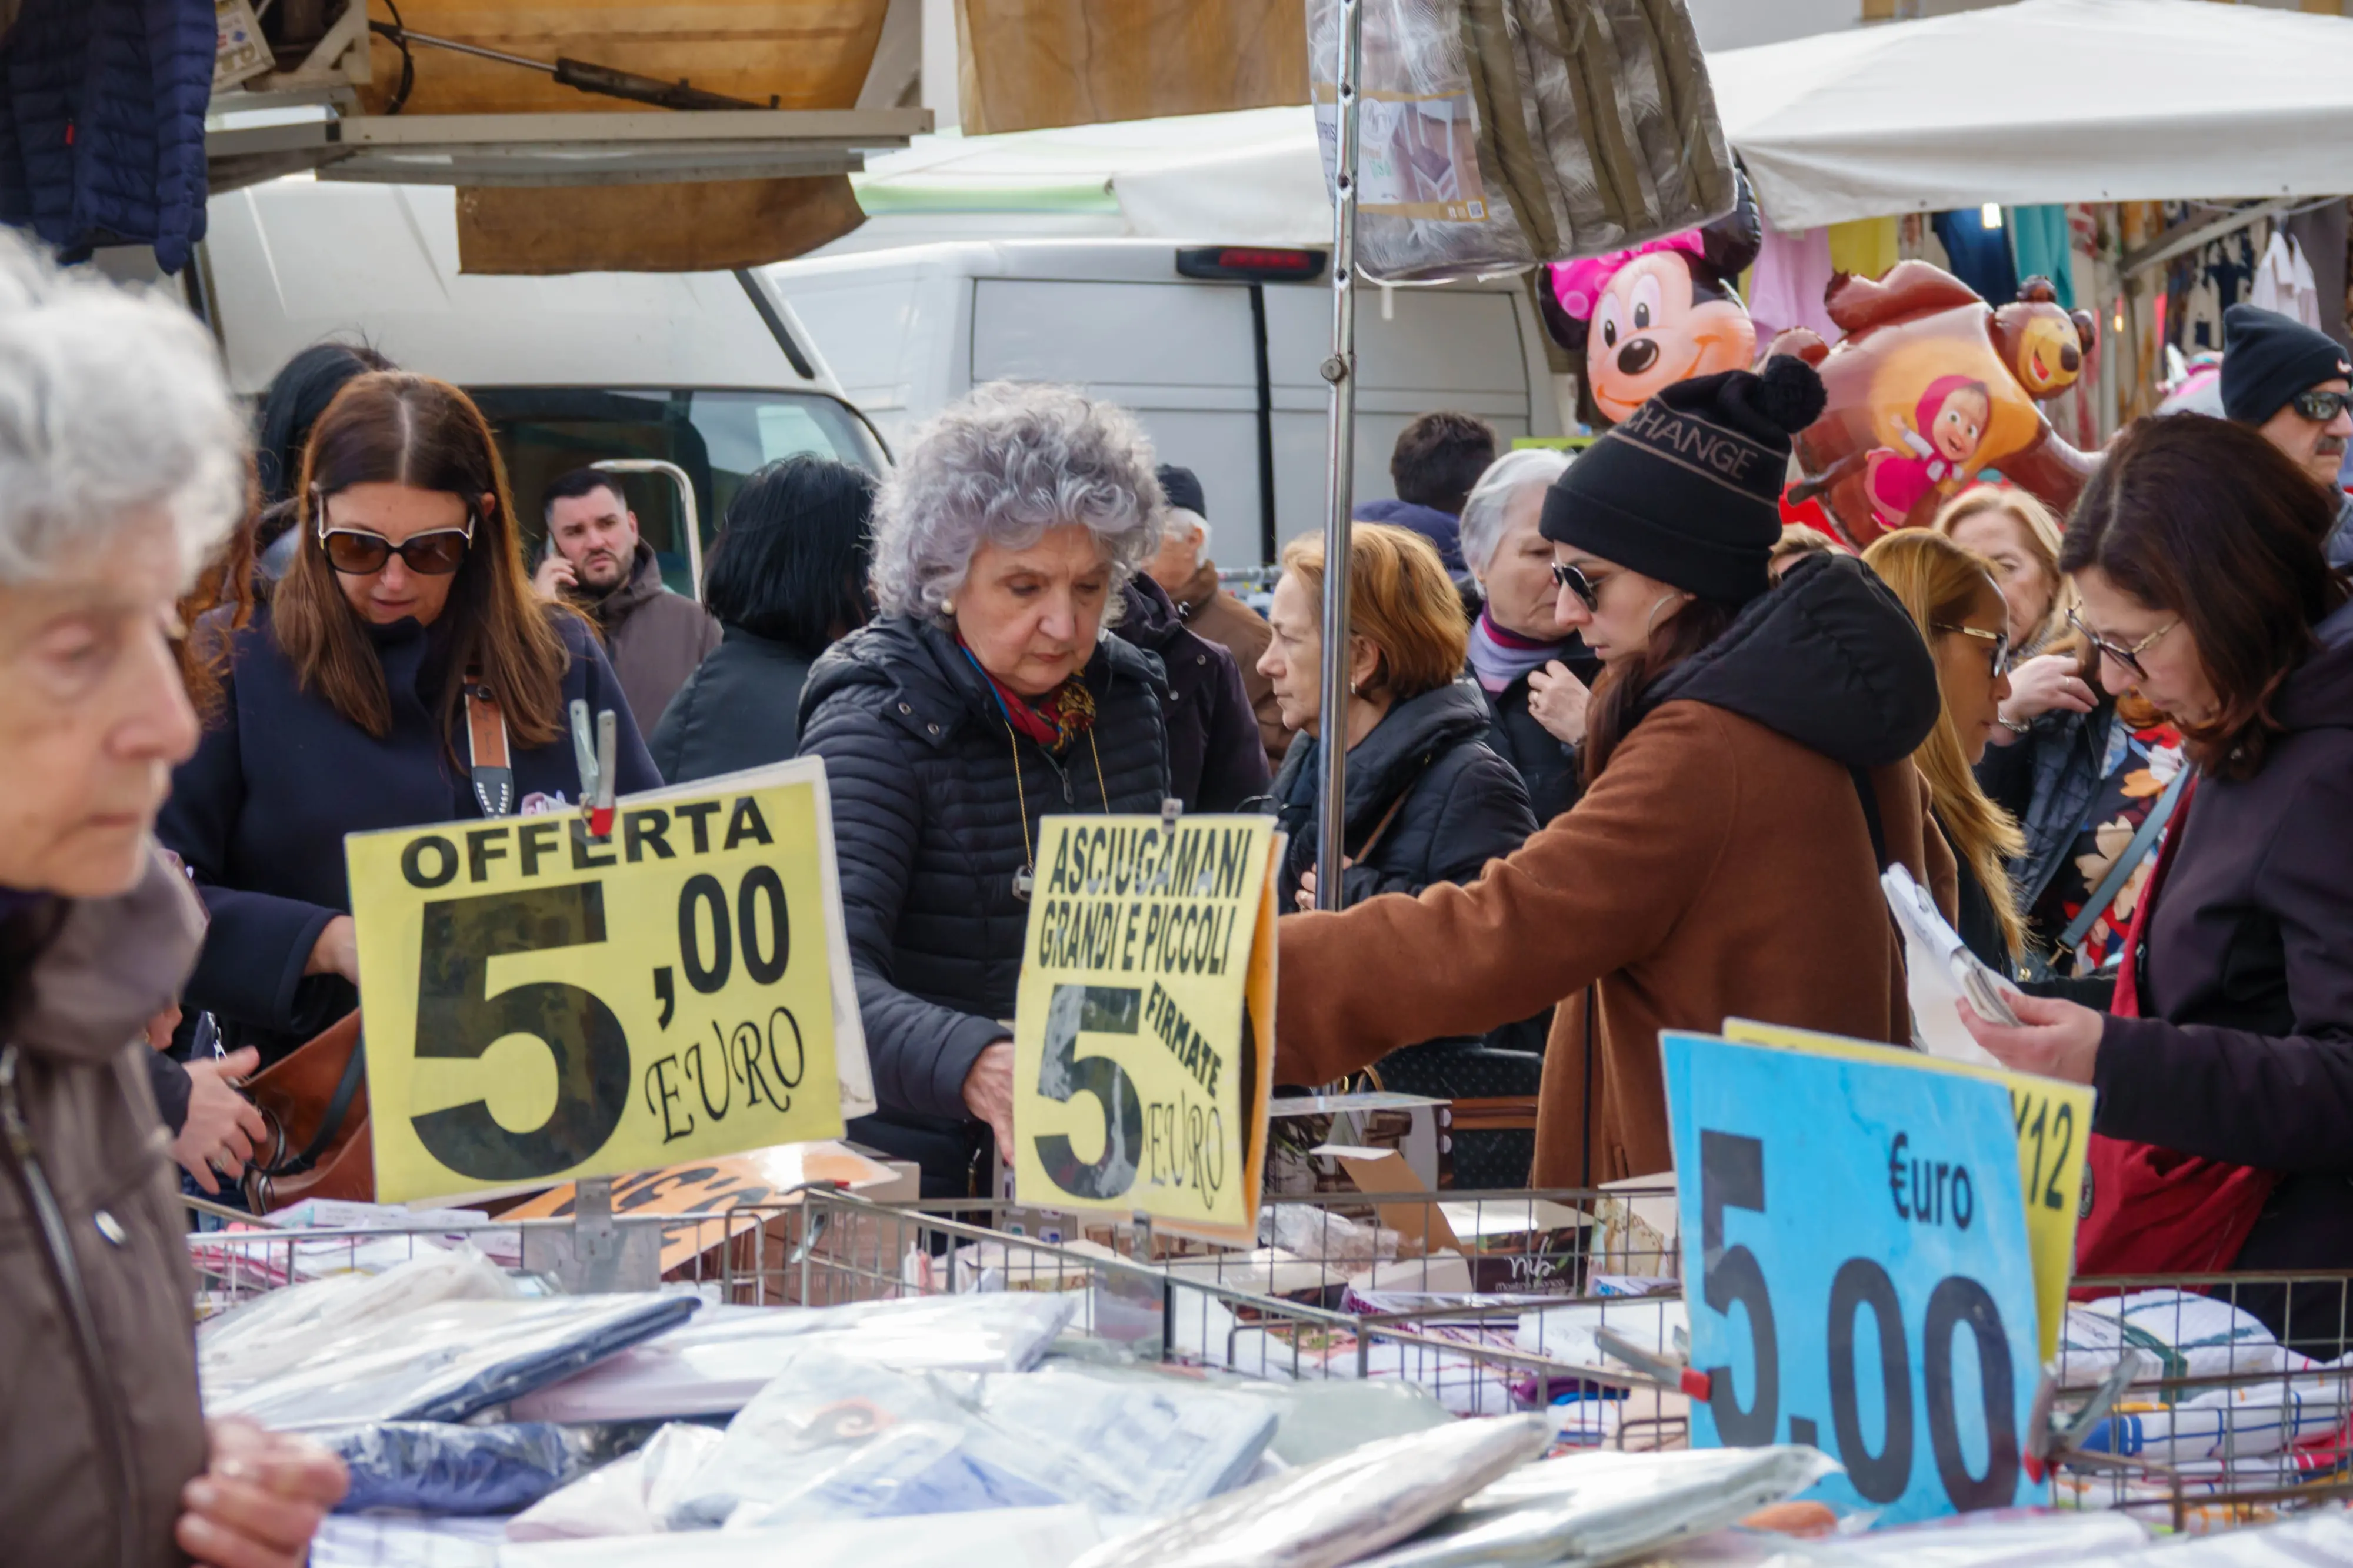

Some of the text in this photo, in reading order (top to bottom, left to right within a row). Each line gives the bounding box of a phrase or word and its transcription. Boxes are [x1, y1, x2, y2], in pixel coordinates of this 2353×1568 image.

[401, 796, 775, 889] OFFERTA
[1048, 826, 1253, 898] ASCIUGAMANI
[1039, 900, 1237, 975] GRANDI E PICCOLI
[645, 1006, 805, 1145] EURO
[1034, 984, 1142, 1200] 5
[1145, 979, 1222, 1099] FIRMATE
[1144, 1090, 1224, 1212] EURO
[1888, 1132, 1974, 1230] €uro
